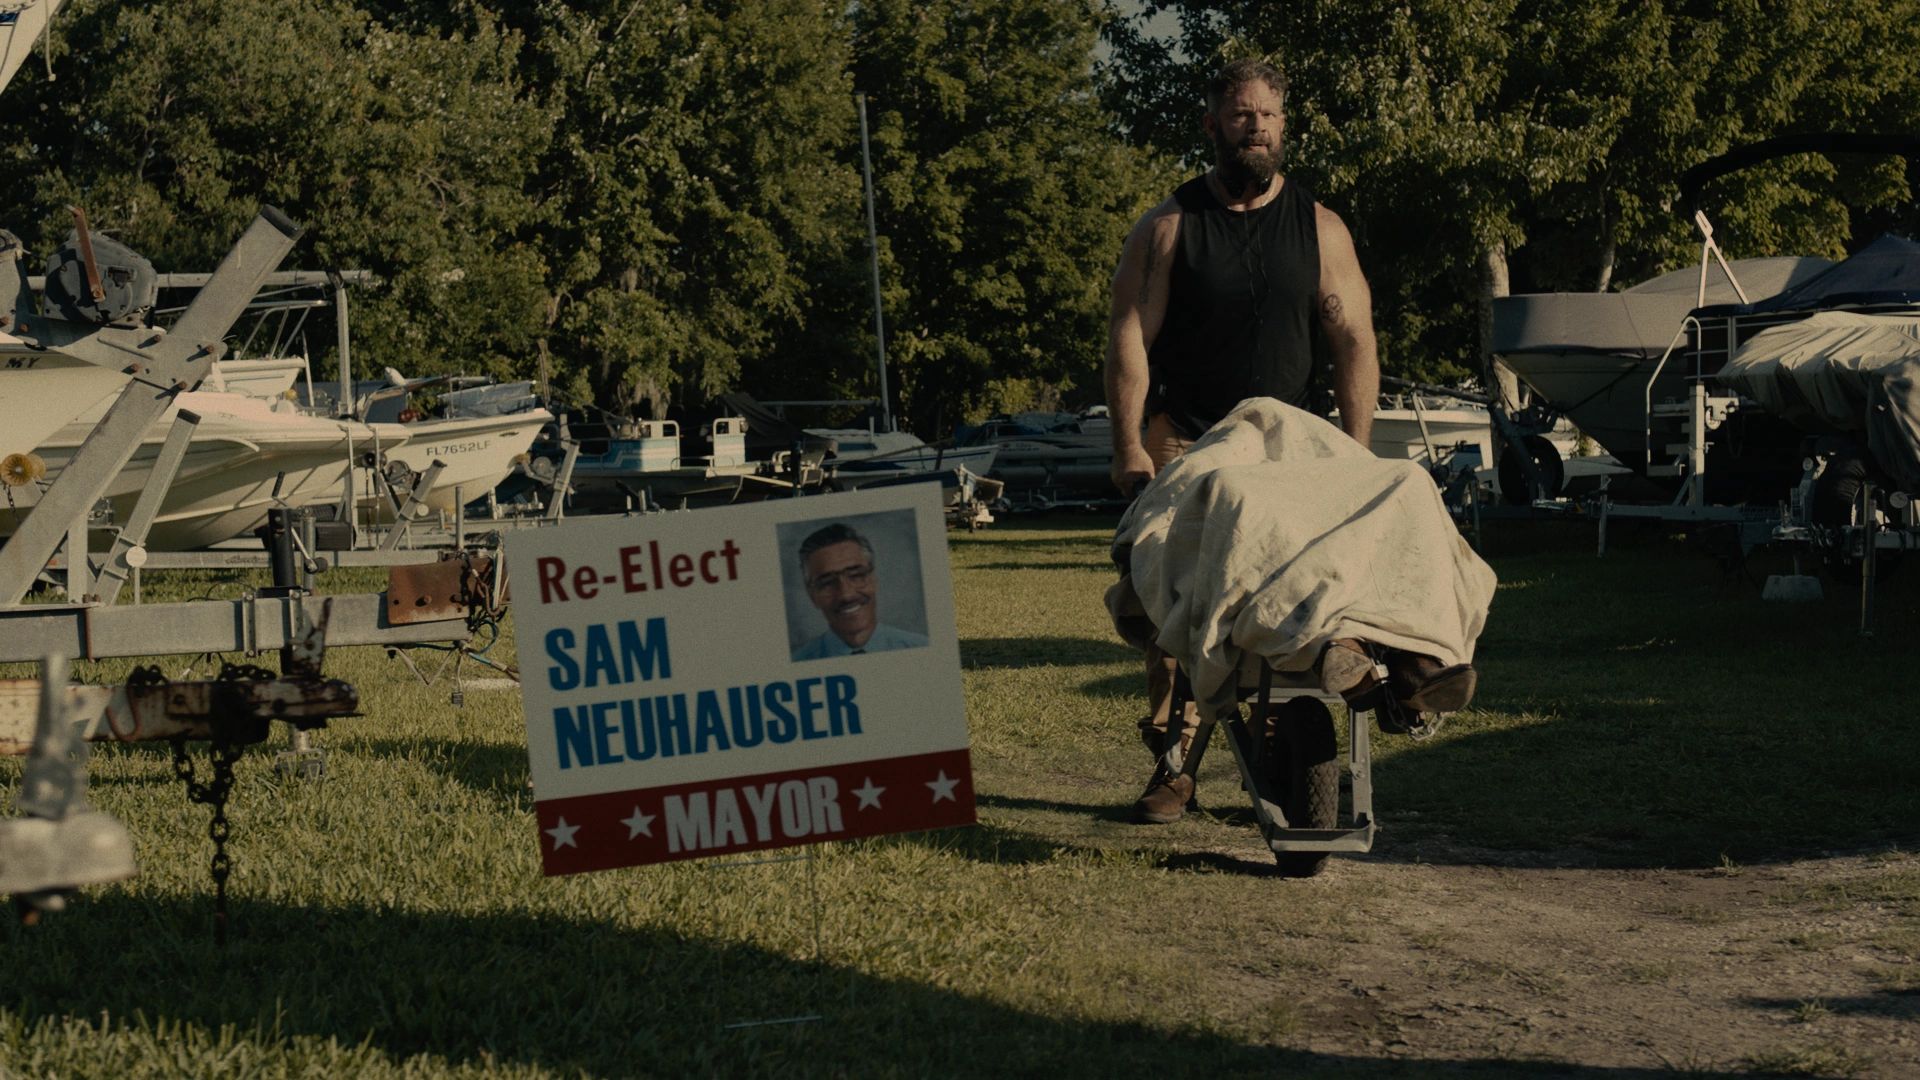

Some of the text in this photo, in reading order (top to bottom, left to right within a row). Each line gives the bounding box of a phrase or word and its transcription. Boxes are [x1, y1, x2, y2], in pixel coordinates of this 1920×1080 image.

[426, 440, 491, 456] FL7652LF
[536, 539, 741, 605] Re-Elect
[544, 616, 672, 692] SAM
[552, 674, 863, 770] NEUHAUSER
[663, 776, 844, 853] MAYOR
